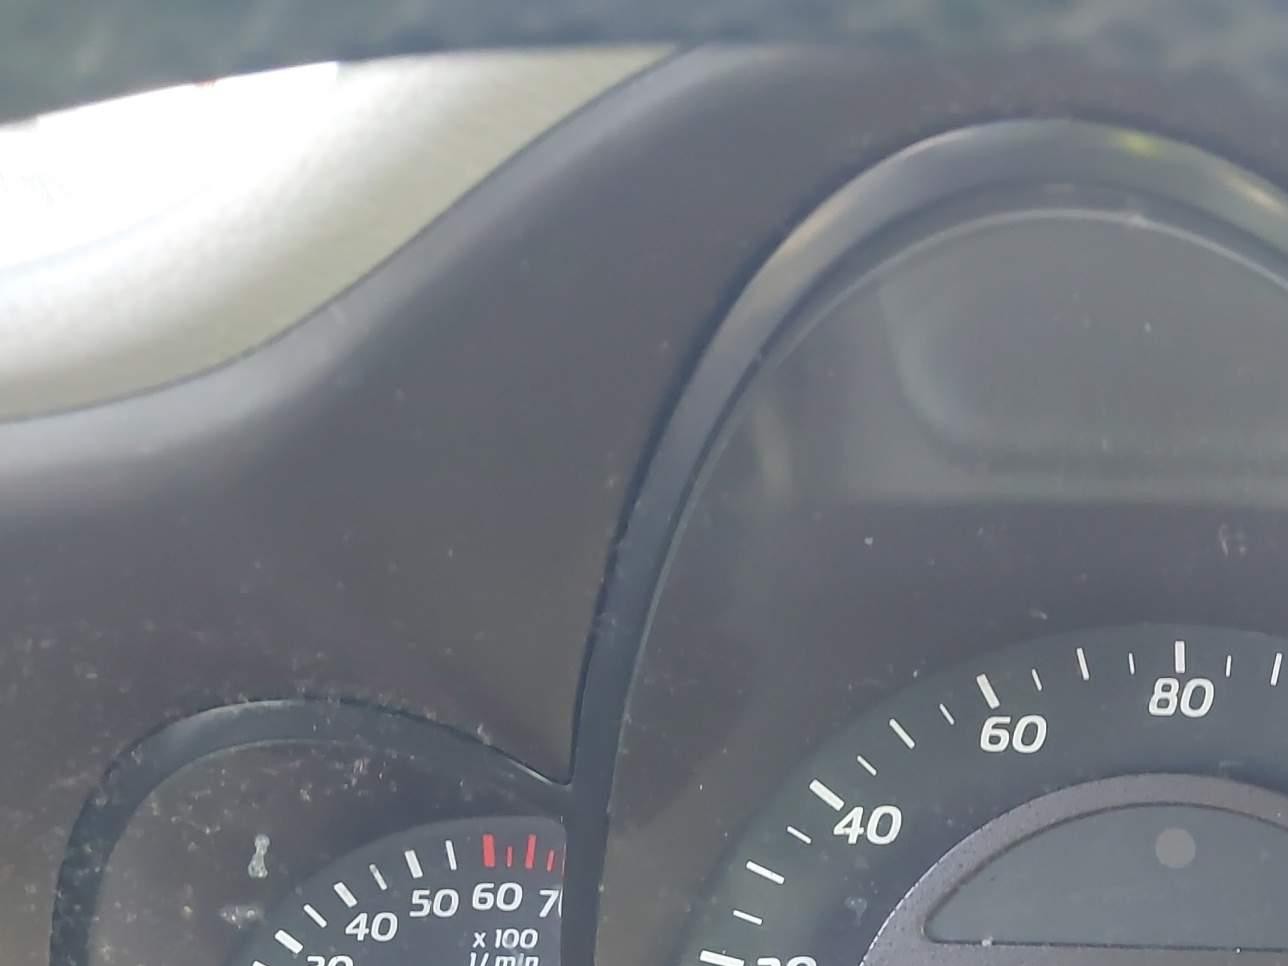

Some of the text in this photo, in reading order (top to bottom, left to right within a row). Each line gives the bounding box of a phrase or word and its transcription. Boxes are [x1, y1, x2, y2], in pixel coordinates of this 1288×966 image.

[1148, 677, 1215, 718] 80
[979, 715, 1048, 753] 60
[833, 805, 902, 845] 40
[409, 888, 458, 918] 50
[471, 882, 523, 911] 60
[345, 913, 399, 942] 40
[494, 928, 539, 949] 100
